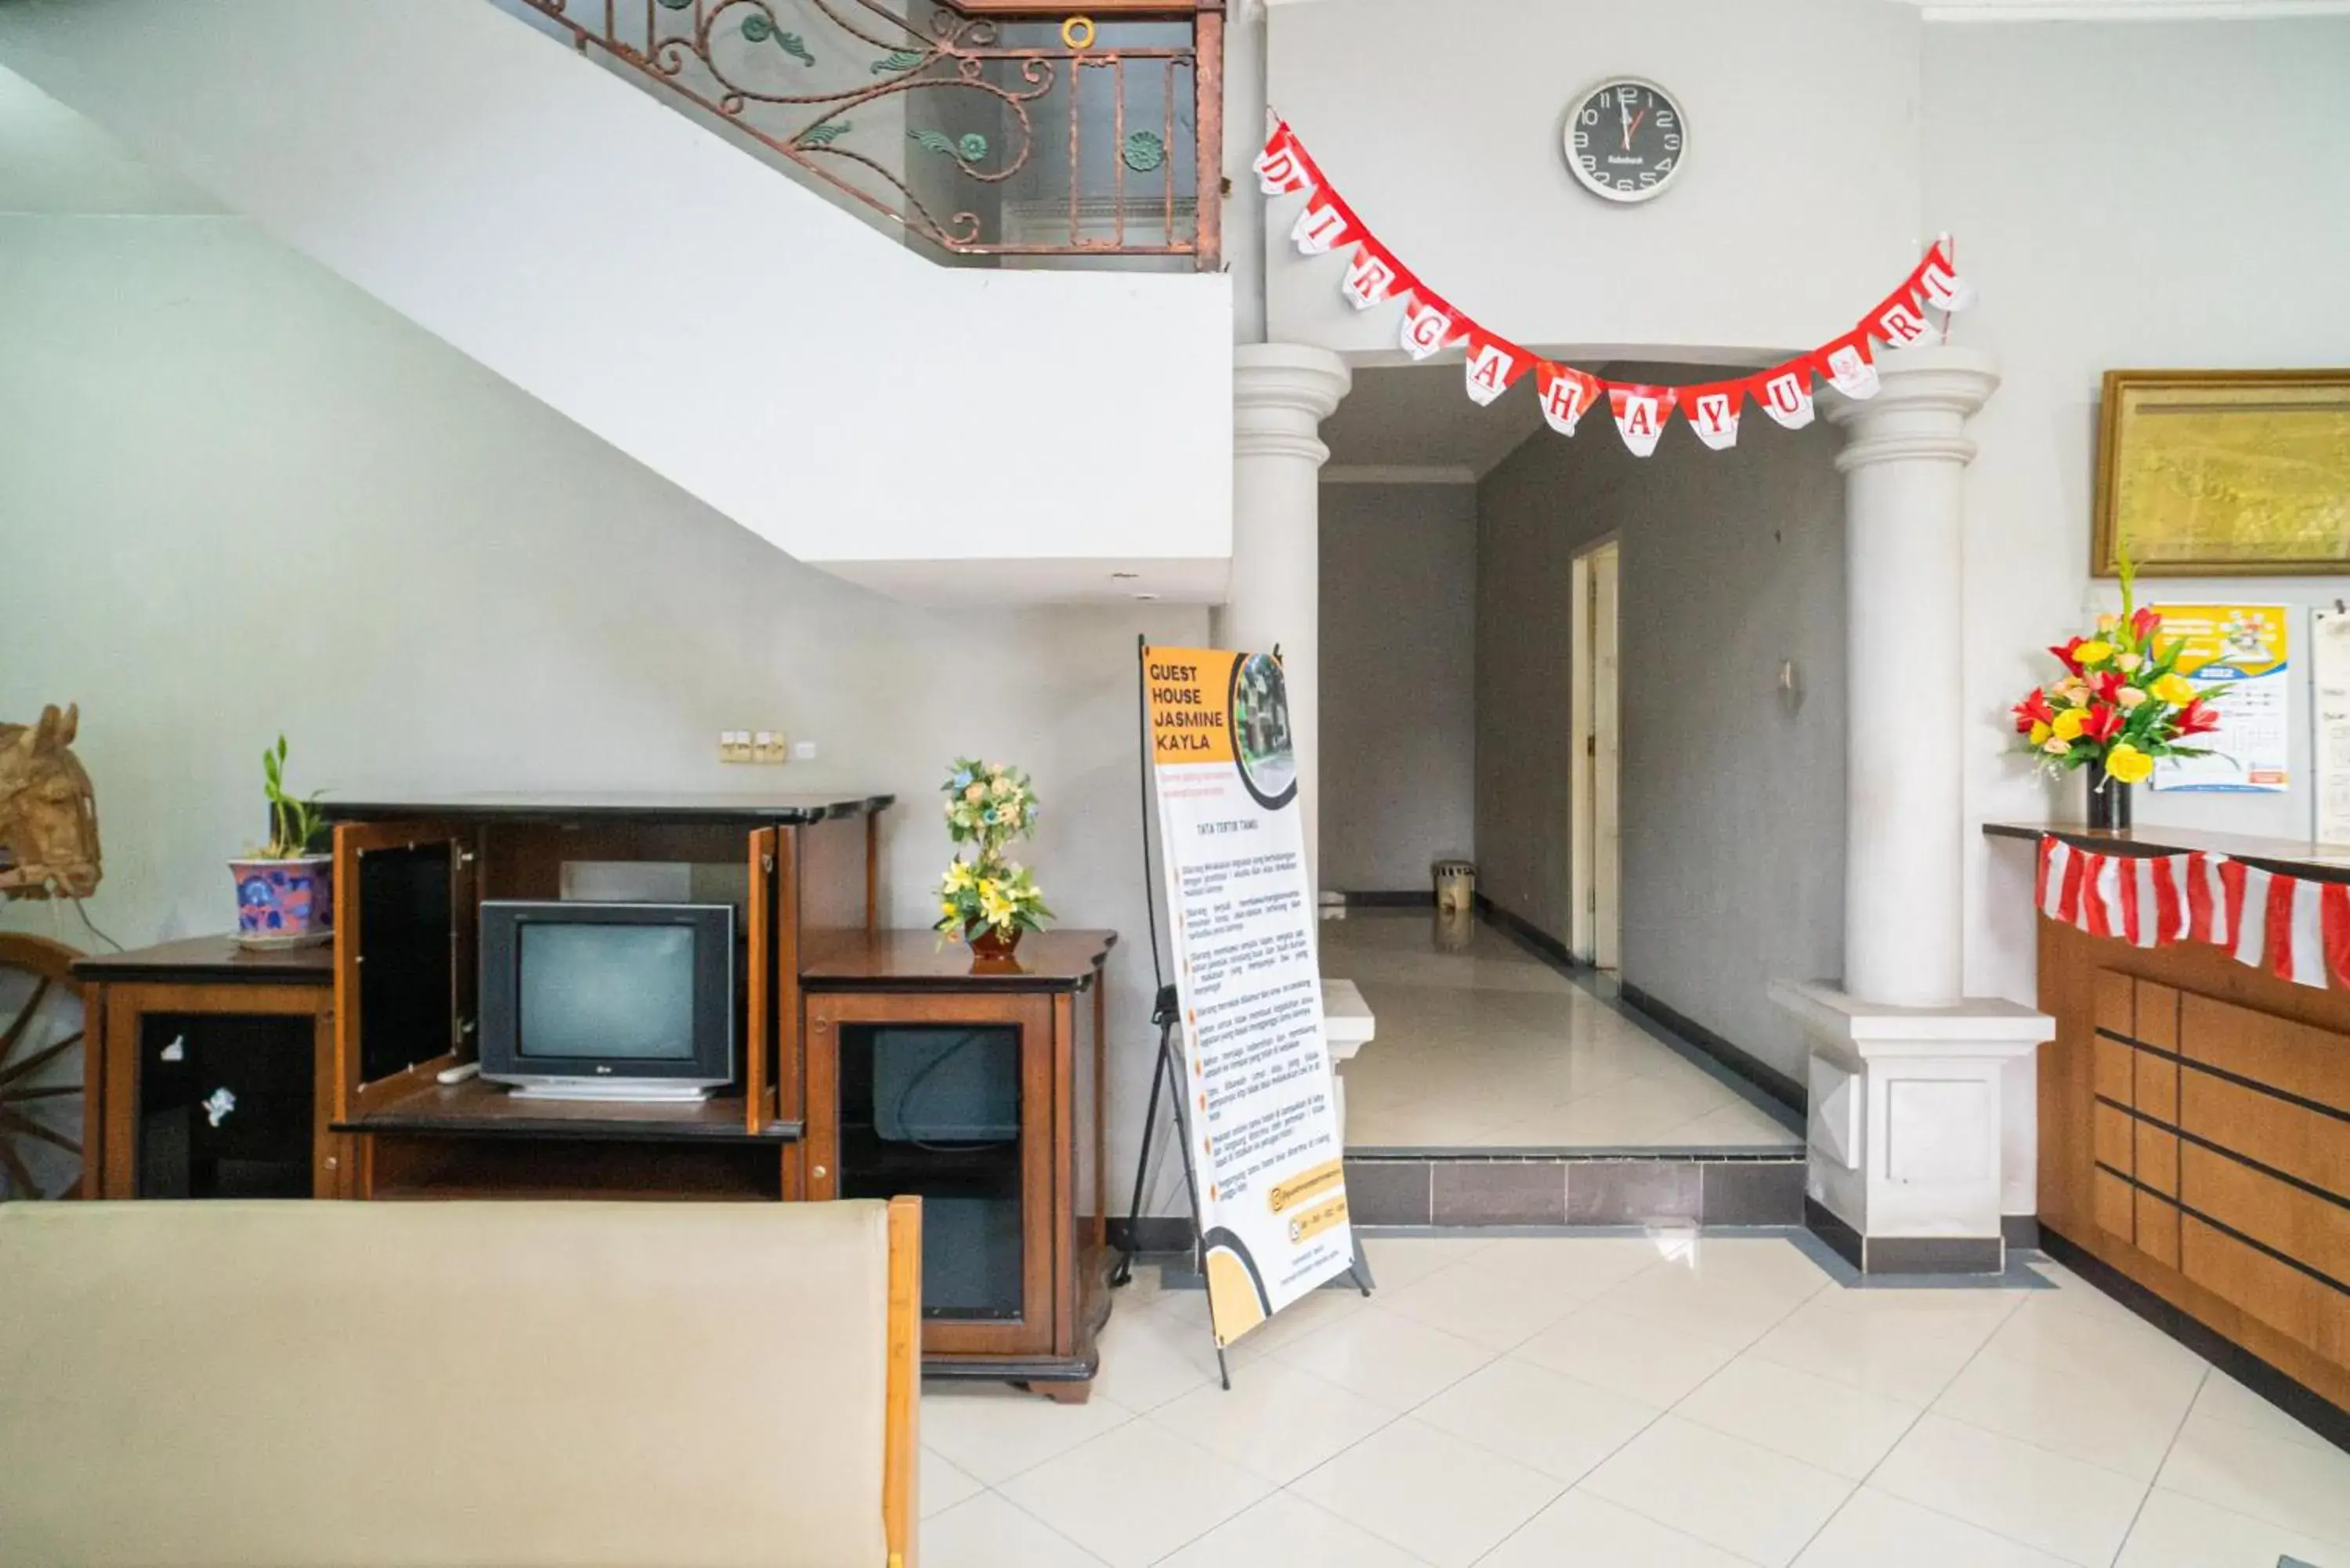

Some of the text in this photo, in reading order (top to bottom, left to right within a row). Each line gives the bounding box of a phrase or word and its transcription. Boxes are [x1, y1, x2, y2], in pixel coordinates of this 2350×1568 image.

[1600, 91, 1611, 108] 11
[1647, 92, 1653, 108] 1
[1581, 108, 1599, 126] 10
[1656, 110, 1674, 127] 2
[1664, 133, 1680, 151] 3
[1654, 157, 1672, 172] 4
[1640, 172, 1657, 188] 5
[1150, 663, 1198, 681] GUEST
[1152, 688, 1202, 704] HOUSE
[1155, 711, 1224, 728] JASMINE
[1156, 733, 1210, 750] KAYLA
